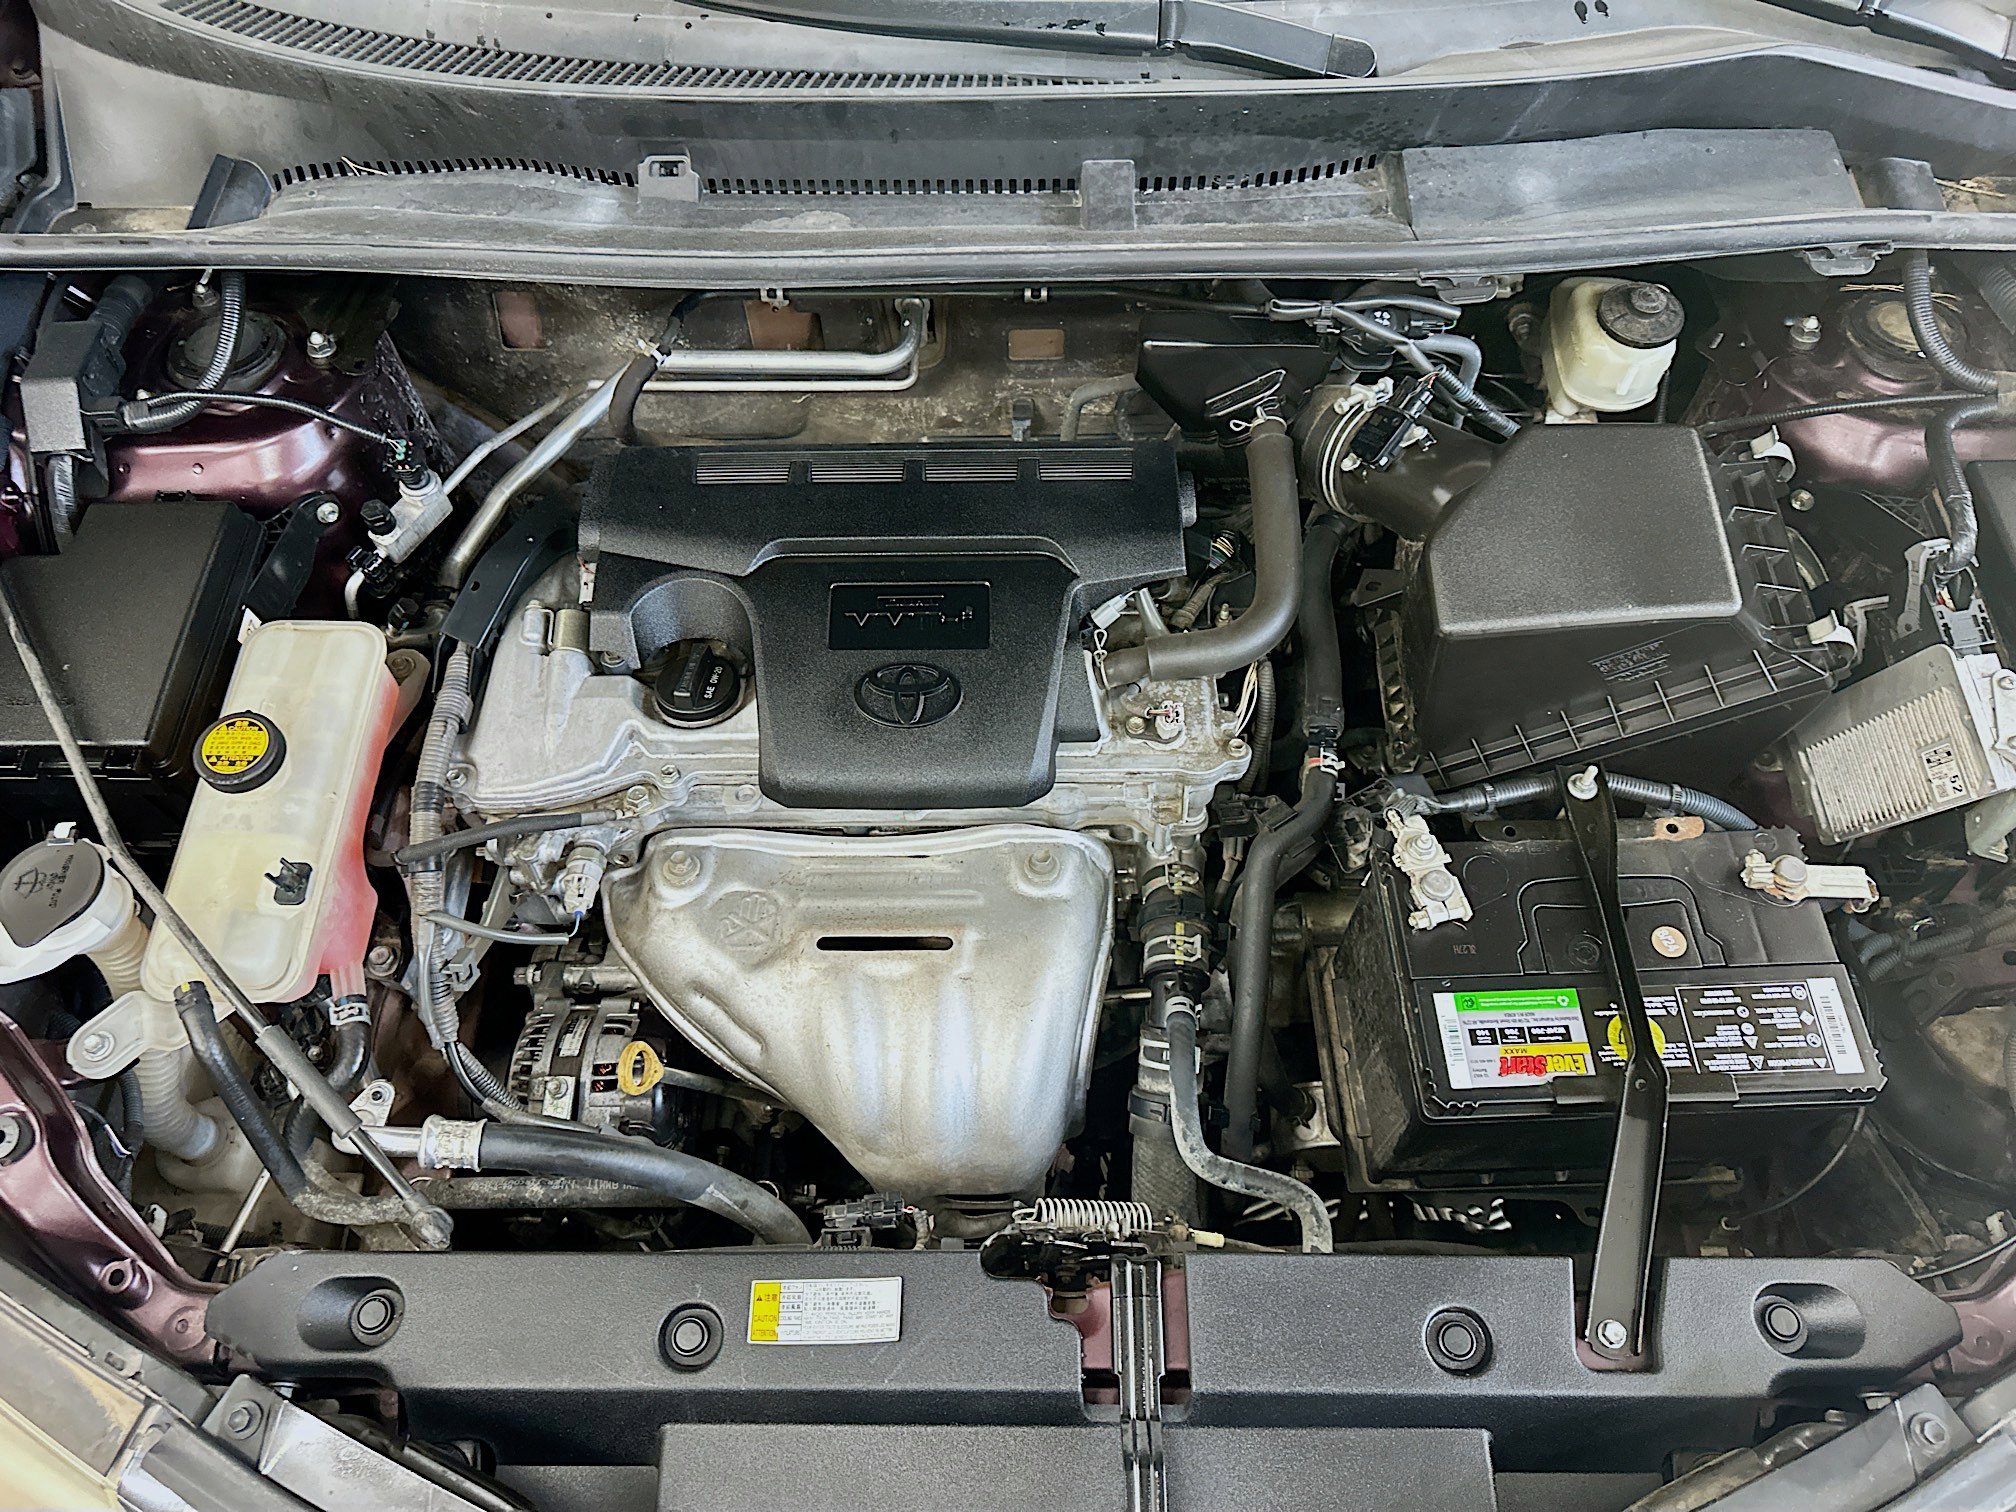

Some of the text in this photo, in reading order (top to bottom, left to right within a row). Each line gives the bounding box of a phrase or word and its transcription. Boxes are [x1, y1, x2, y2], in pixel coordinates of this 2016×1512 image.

[703, 666, 724, 700] SAE 0W-20
[1503, 1047, 1528, 1055] MAXX
[1497, 1053, 1588, 1078] EverStart
[753, 1315, 778, 1323] CAUTION
